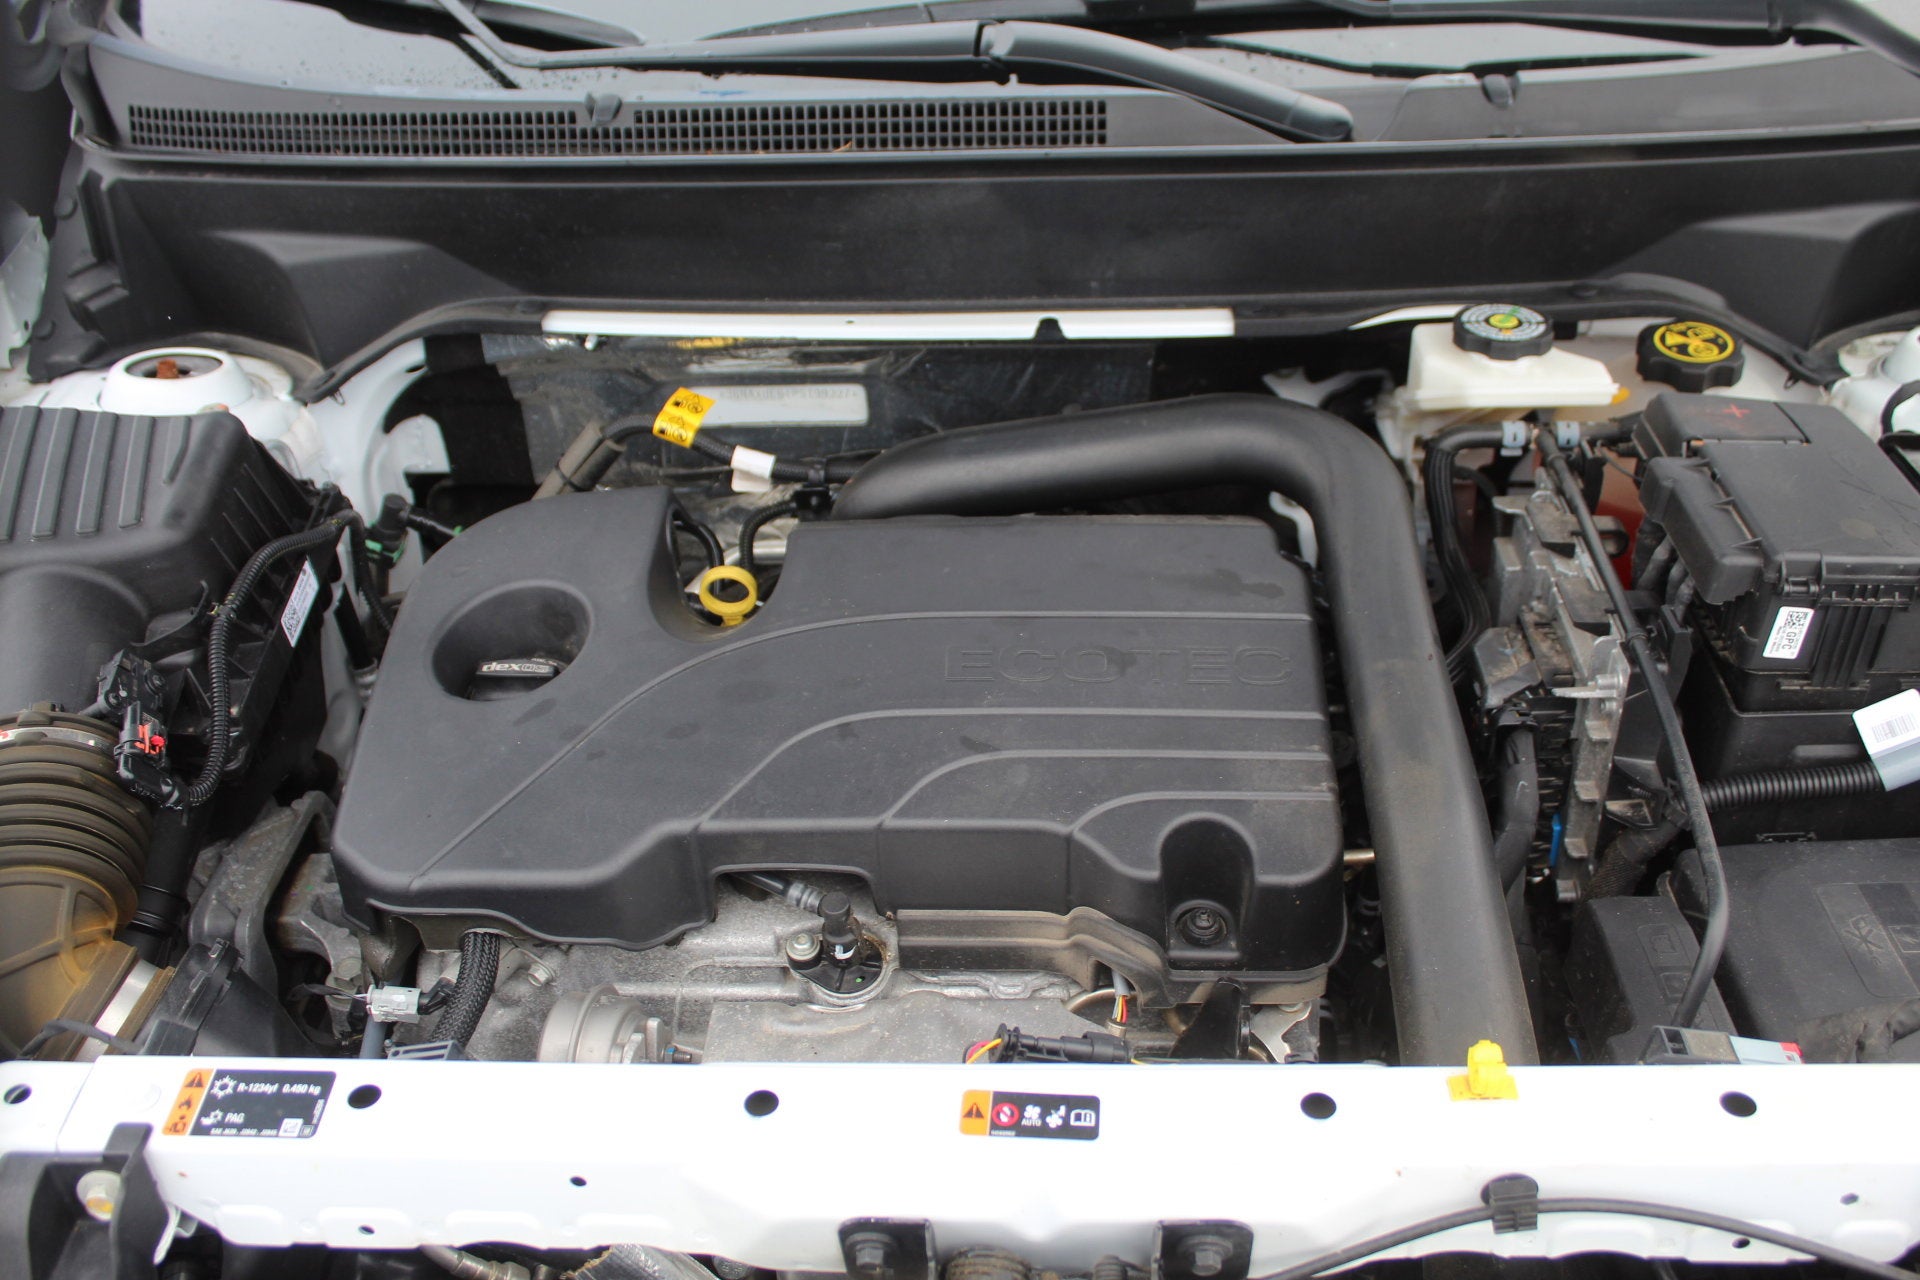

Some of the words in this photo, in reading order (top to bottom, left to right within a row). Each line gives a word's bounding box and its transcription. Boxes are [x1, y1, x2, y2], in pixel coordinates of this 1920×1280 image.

[1781, 631, 1797, 649] GPC
[481, 661, 550, 673] dexos
[944, 645, 1293, 686] ECOTEC
[237, 1082, 279, 1095] R-1234yf
[308, 1084, 322, 1096] kg
[224, 1112, 245, 1124] PAG
[1021, 1118, 1042, 1127] AUTO
